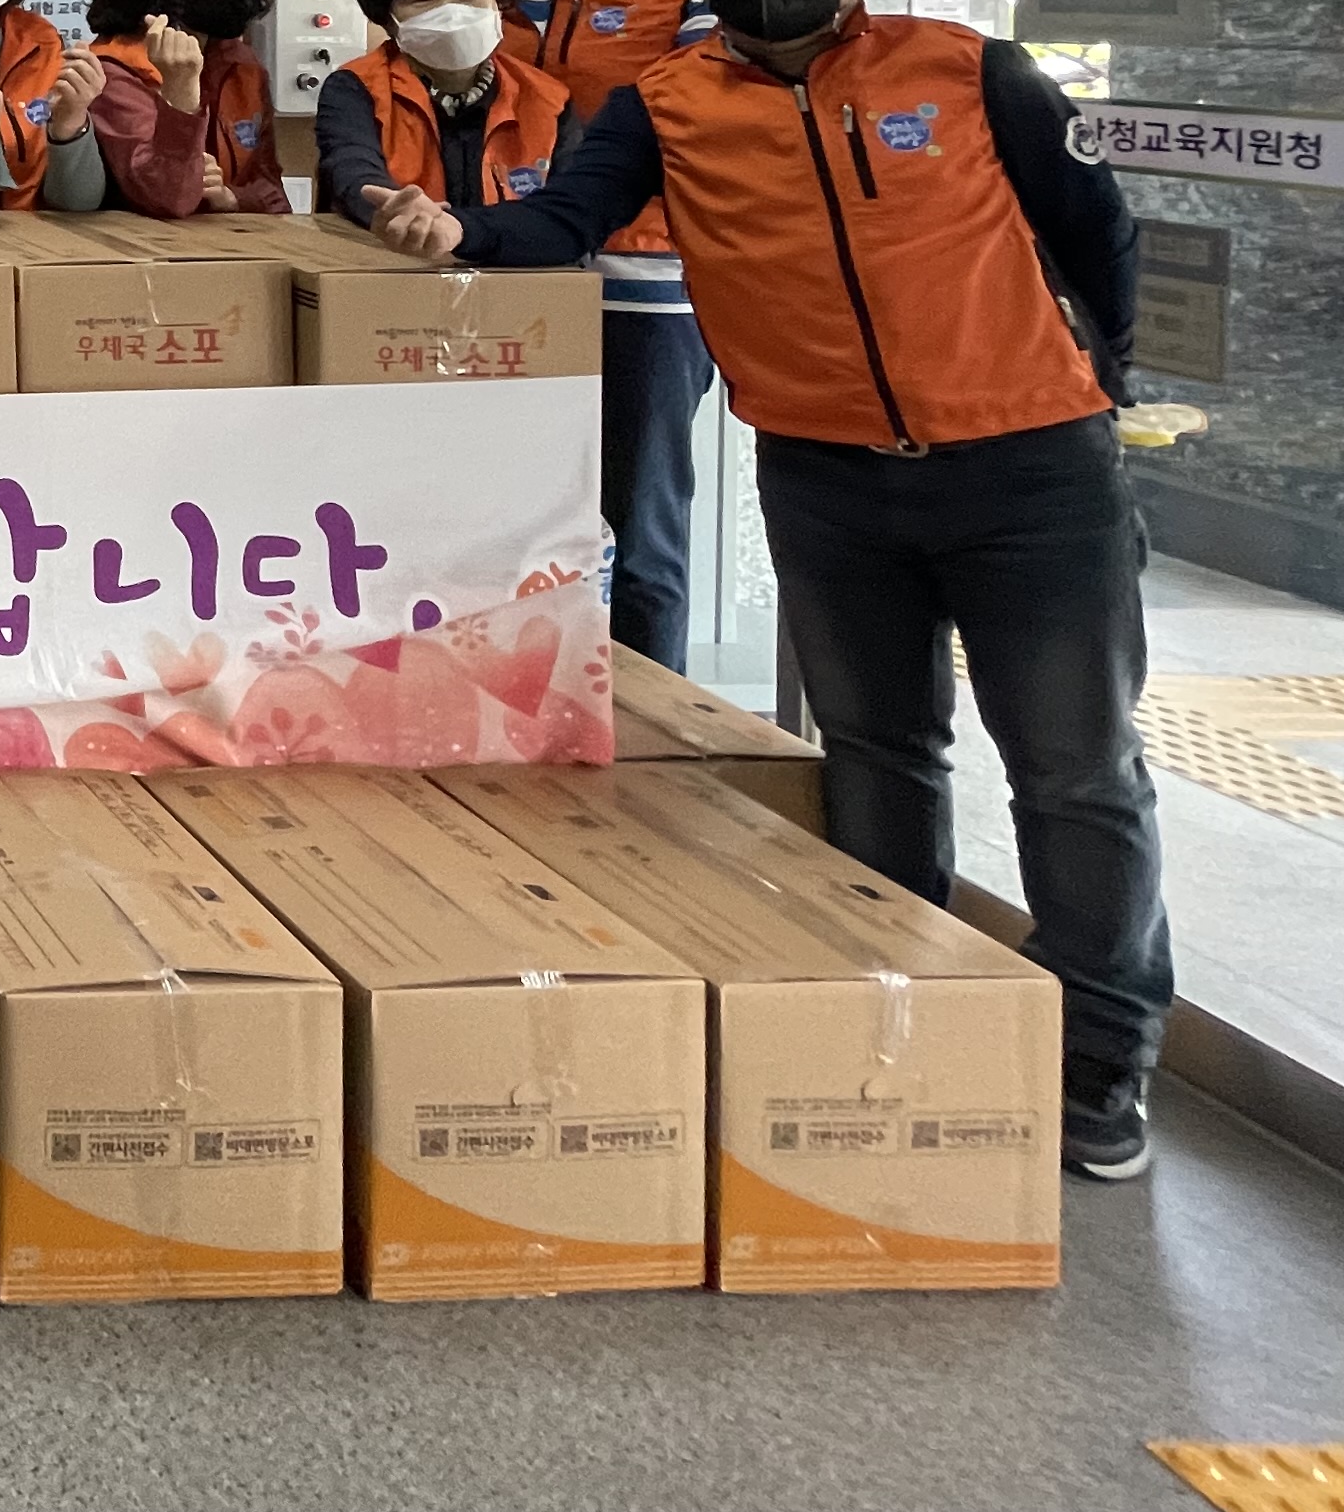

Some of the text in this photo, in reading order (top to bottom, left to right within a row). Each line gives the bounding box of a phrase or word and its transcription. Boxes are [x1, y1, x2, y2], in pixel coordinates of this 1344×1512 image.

[75, 329, 223, 364] 우체국 소포
[456, 342, 527, 377] 소포
